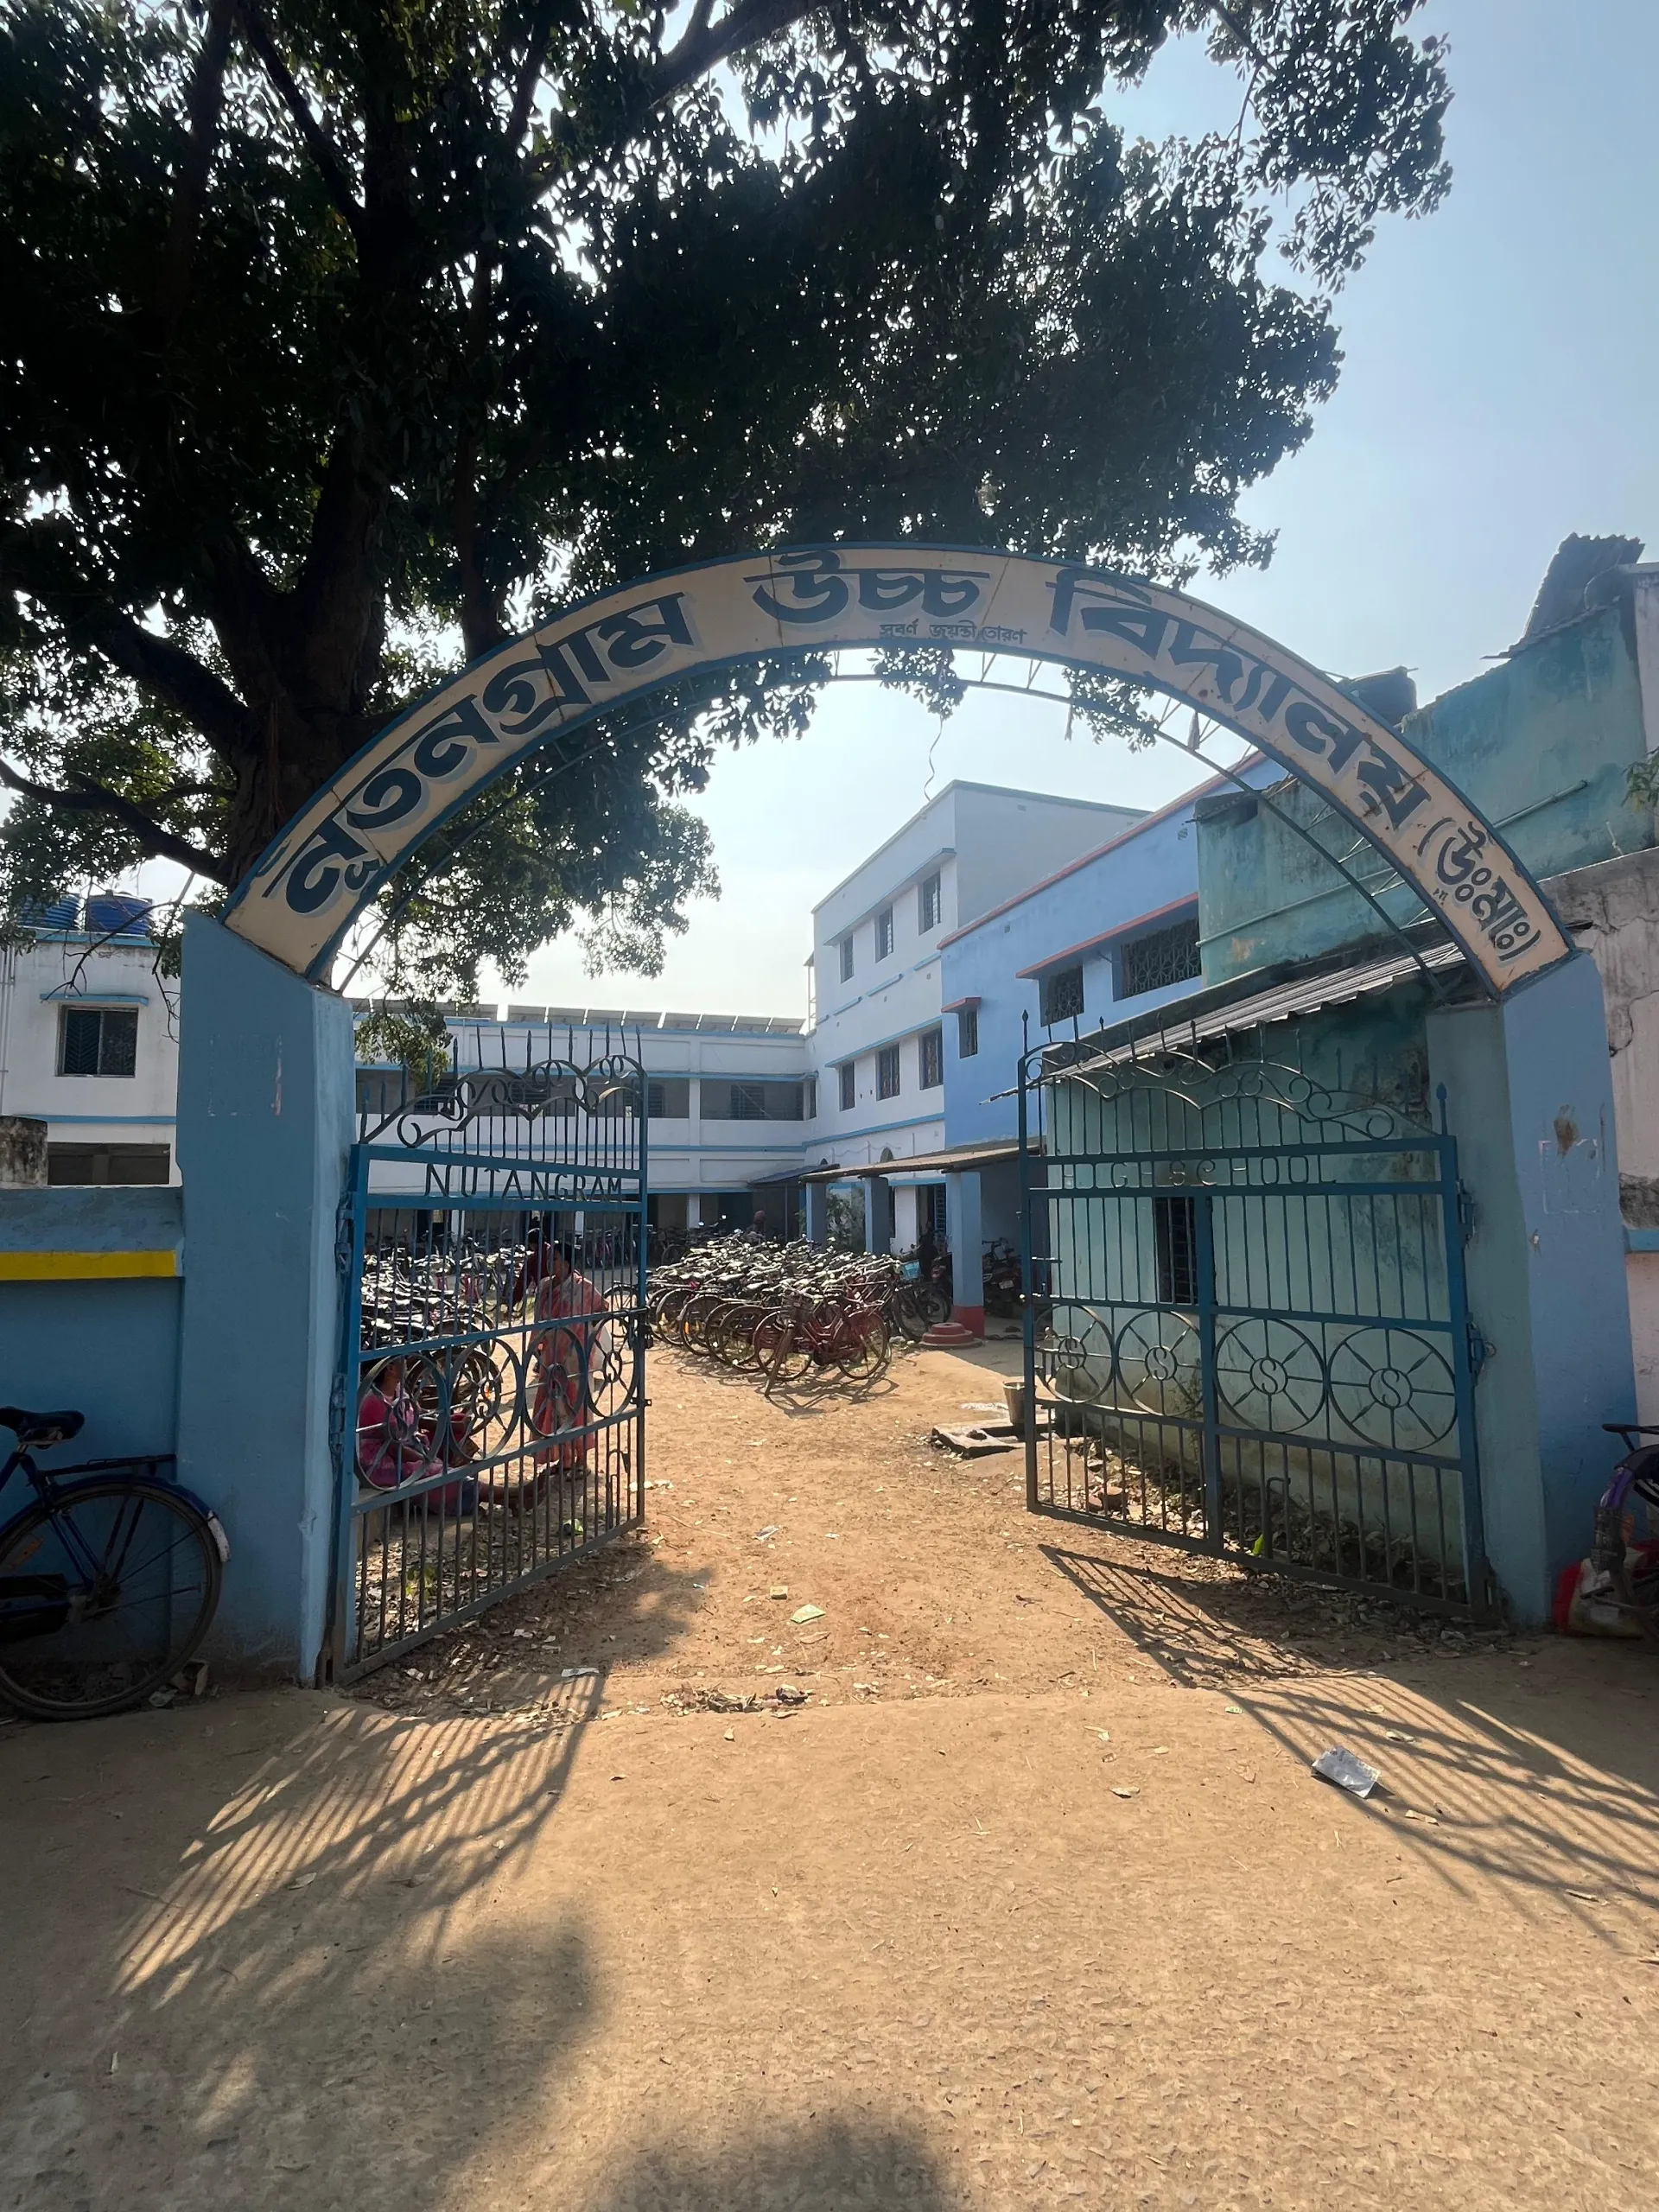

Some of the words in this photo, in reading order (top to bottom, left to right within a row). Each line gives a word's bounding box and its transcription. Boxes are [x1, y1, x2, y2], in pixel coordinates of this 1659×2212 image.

[743, 550, 991, 624] উচ্চ
[1045, 567, 1432, 830] বিদ্যালয়
[424, 1162, 622, 1203] NUTANGRAM
[1060, 1161, 1155, 1189] HIGH
[1169, 1154, 1337, 1187] SCHOOL
